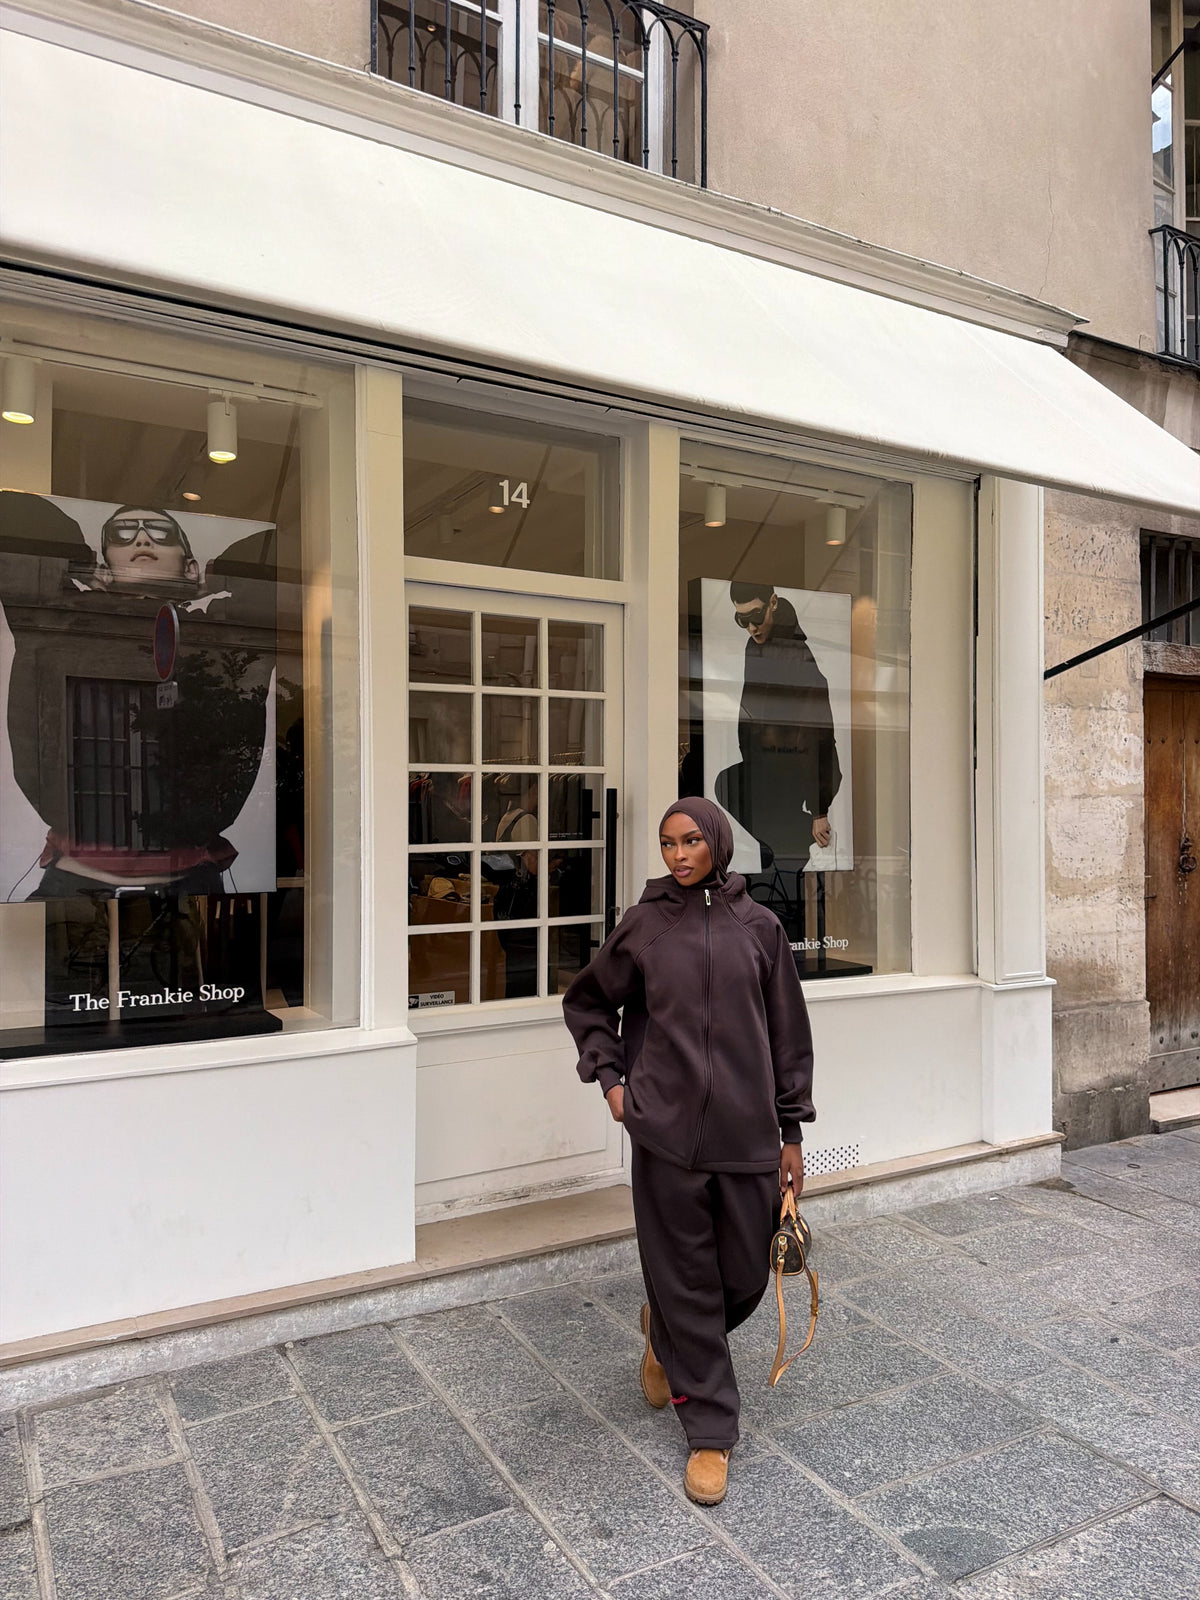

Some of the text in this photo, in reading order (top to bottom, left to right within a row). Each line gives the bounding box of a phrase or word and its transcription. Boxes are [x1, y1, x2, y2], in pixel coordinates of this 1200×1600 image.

[499, 479, 530, 509] 14
[823, 936, 849, 950] Shop
[69, 984, 245, 1012] The Frankie Shop
